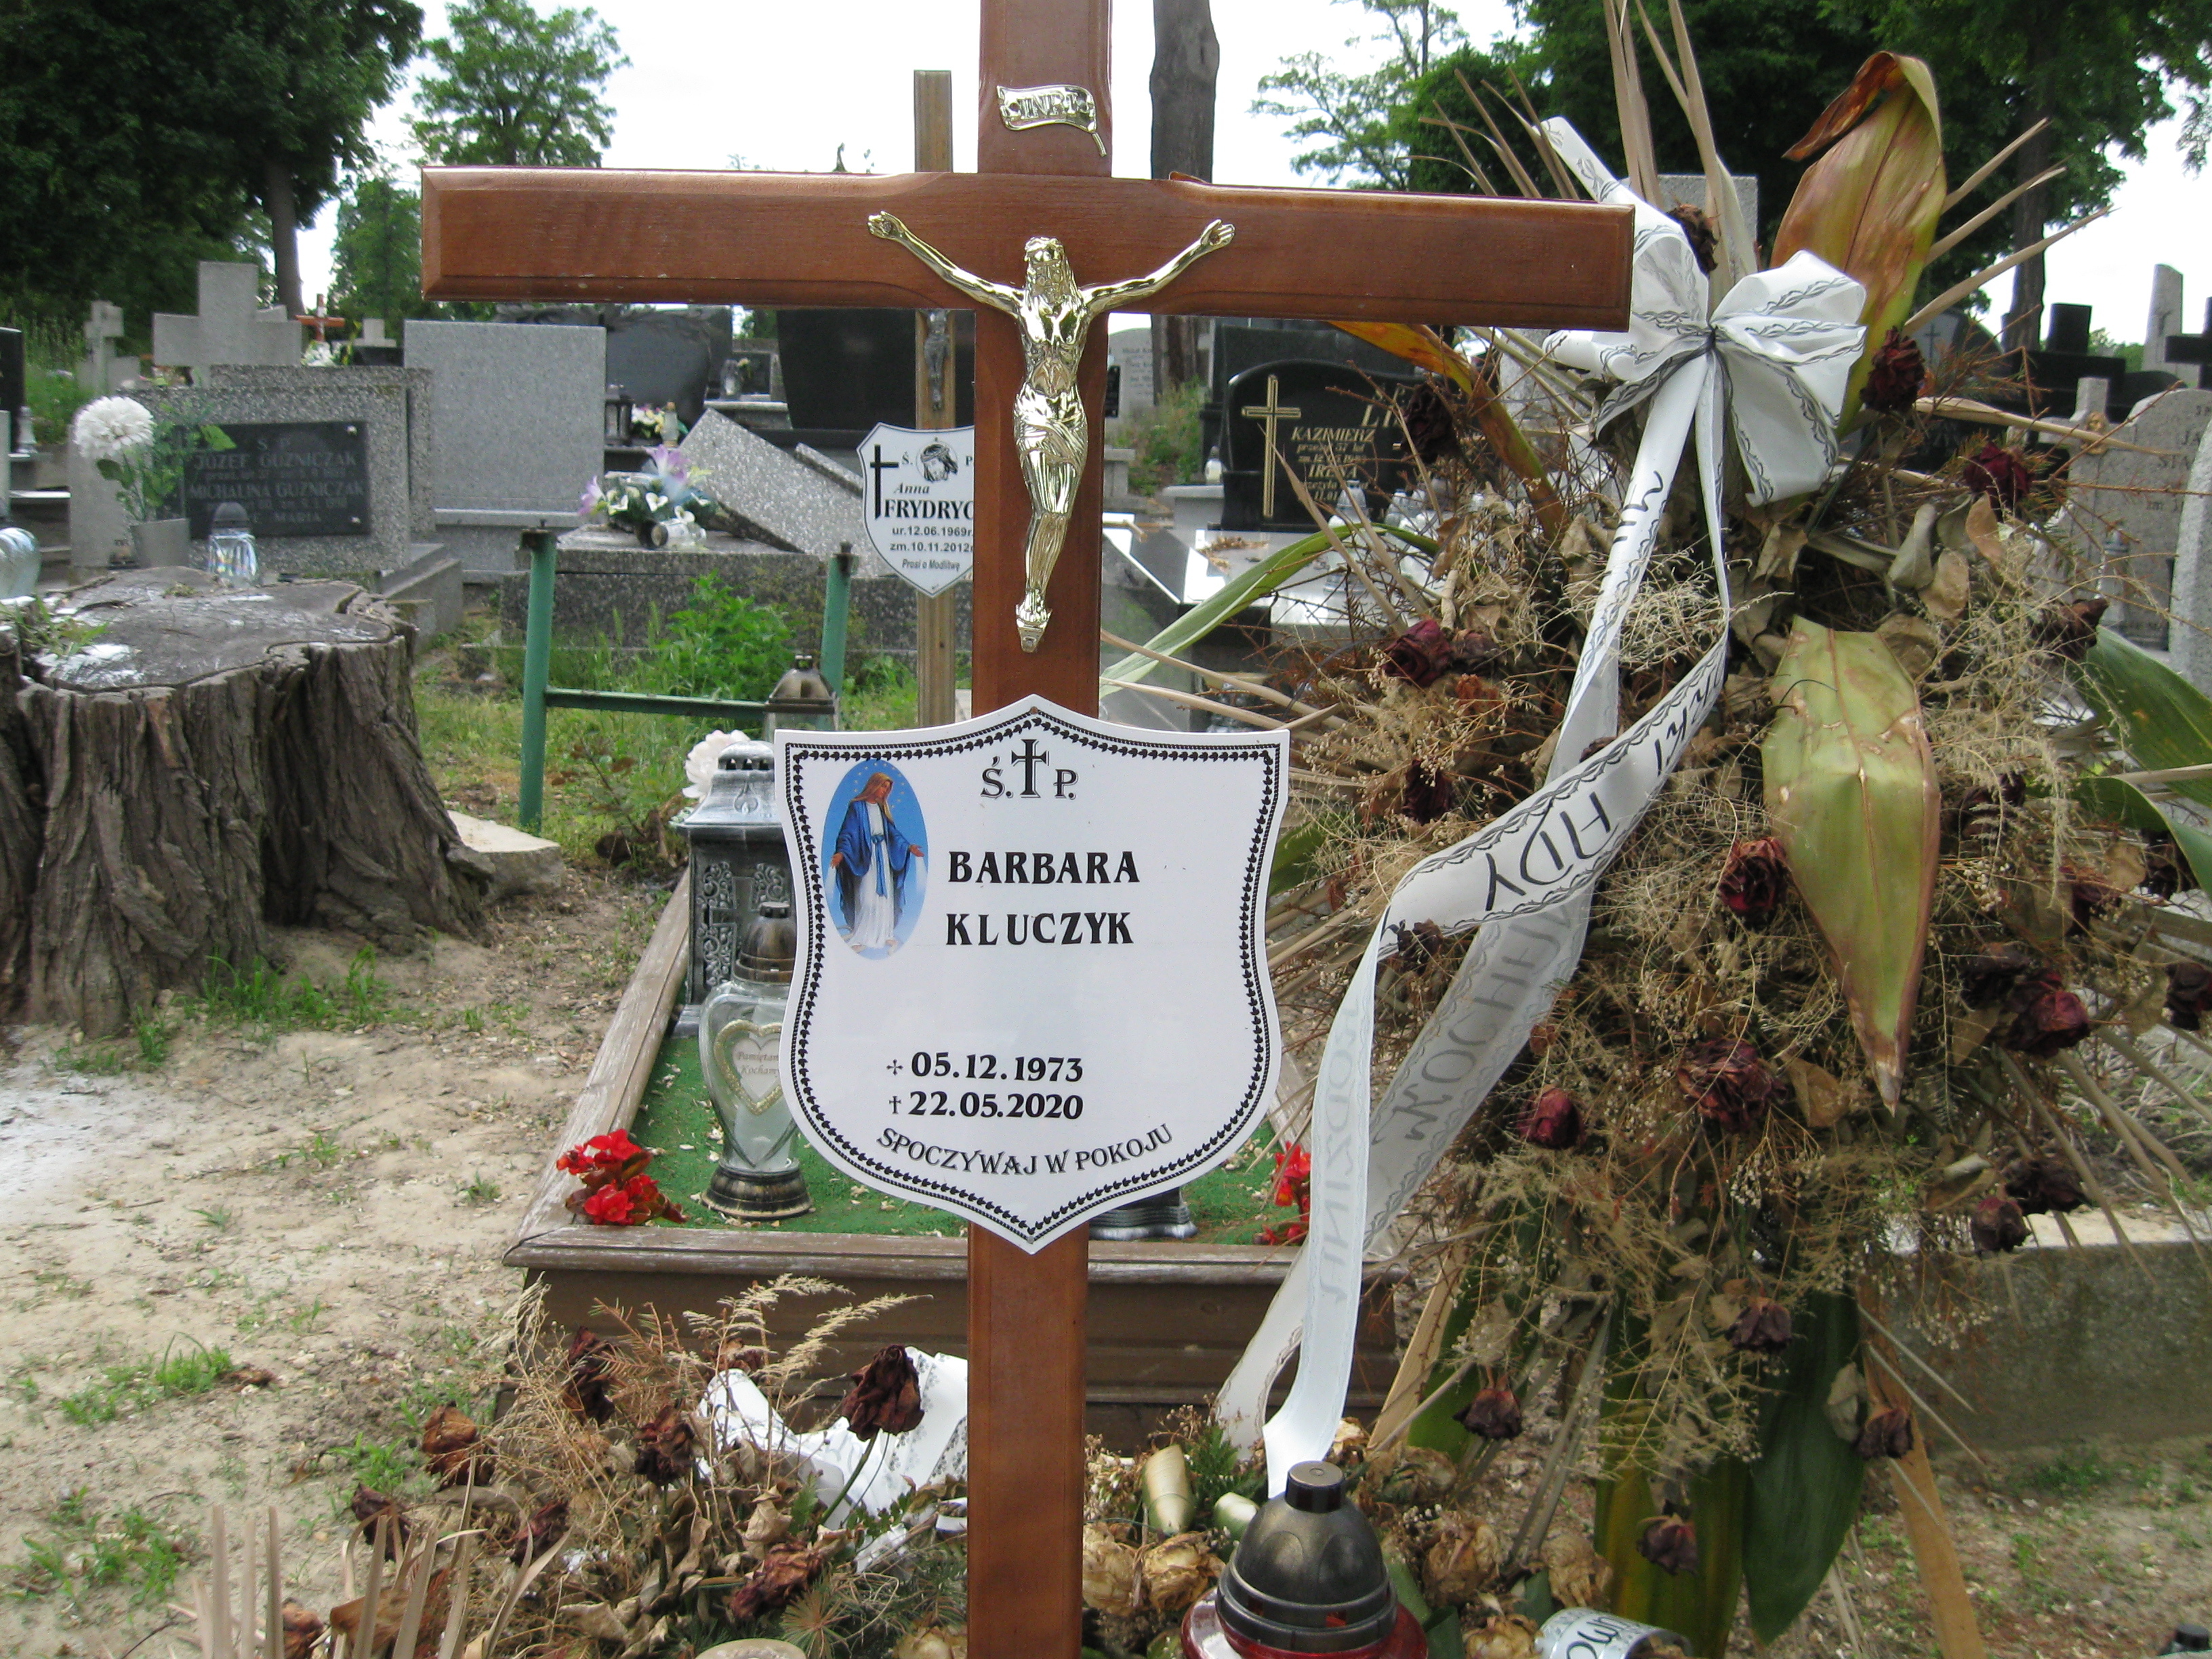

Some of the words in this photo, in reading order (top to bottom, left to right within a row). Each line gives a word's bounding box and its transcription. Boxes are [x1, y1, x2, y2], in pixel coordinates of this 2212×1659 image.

[1017, 93, 1079, 120] INRI
[1291, 426, 1376, 441] KAZIMIERZ
[894, 482, 930, 494] Anna
[981, 756, 1014, 799] Ś.
[1054, 769, 1080, 800] P.
[948, 850, 1141, 884] BARBARA
[946, 912, 1134, 946] KLUCZYK
[908, 1090, 1084, 1120] 22.05.2020
[876, 1127, 1038, 1175] SPOCZYWAJ
[1044, 1149, 1070, 1174] W
[1076, 1123, 1173, 1171] POKOJU
